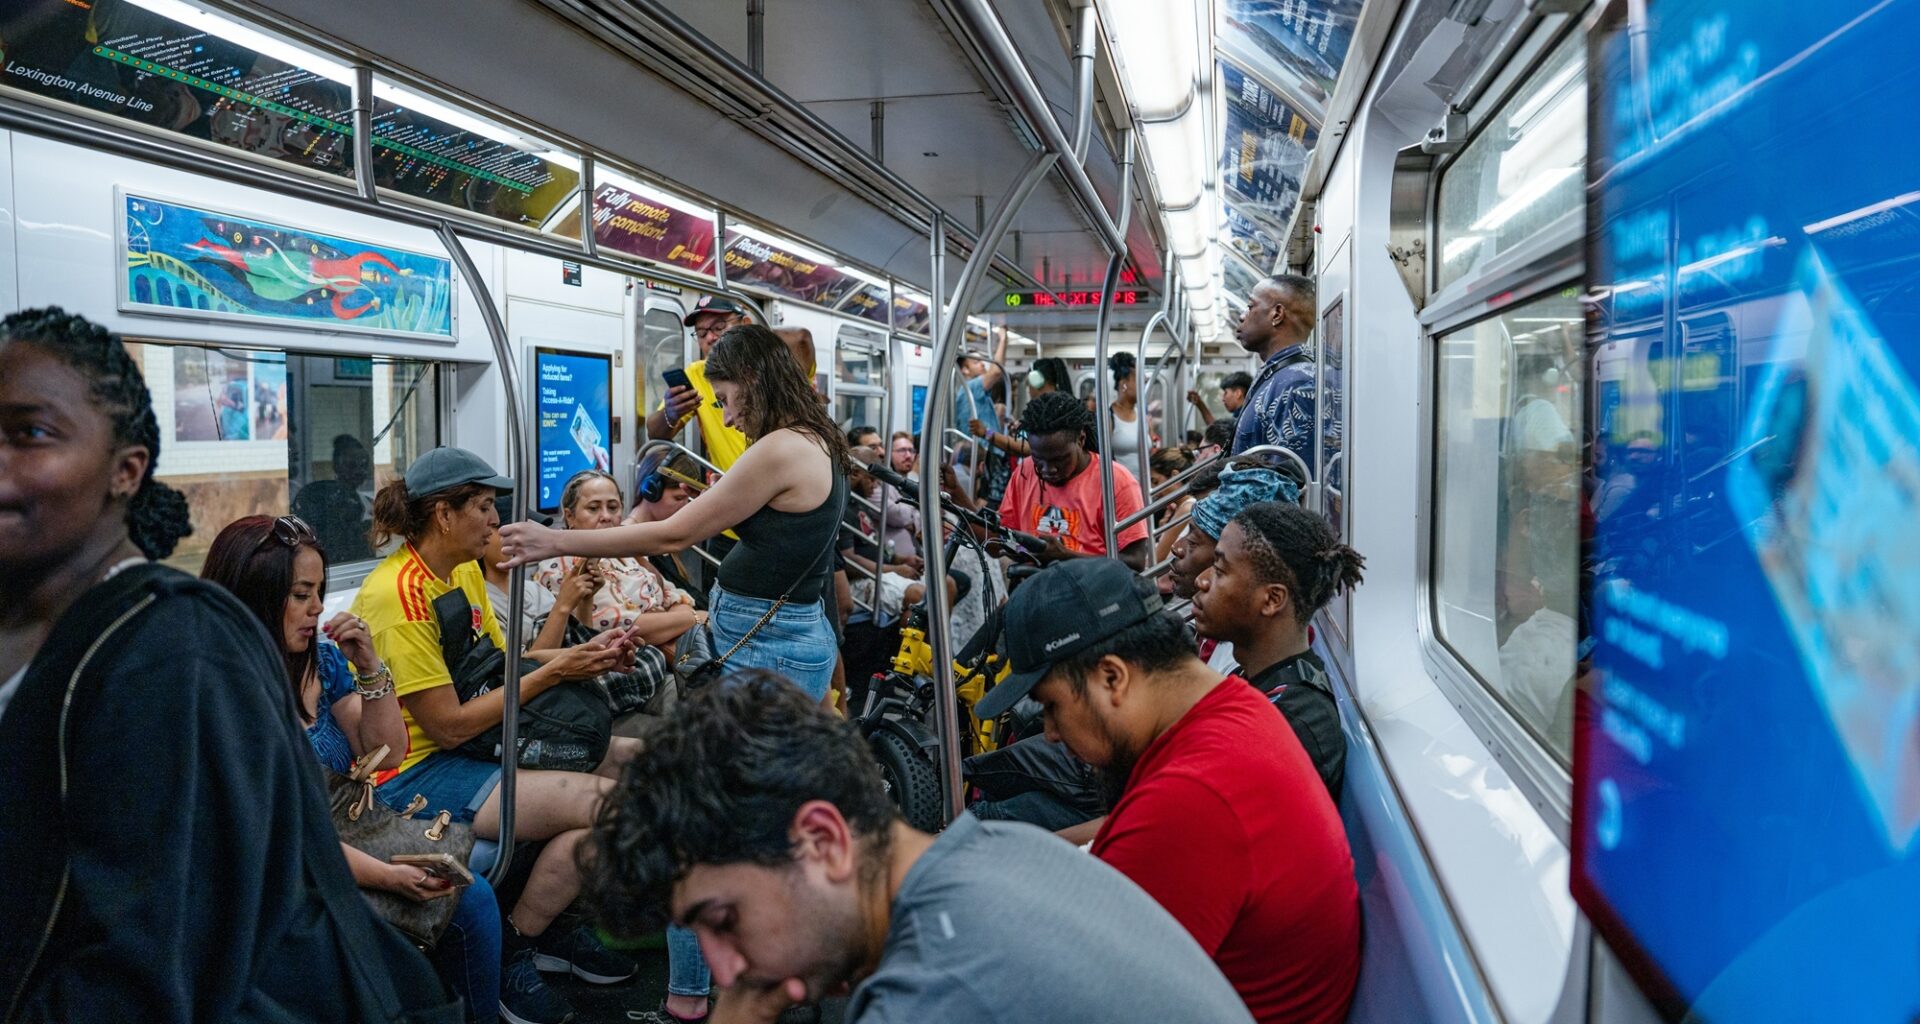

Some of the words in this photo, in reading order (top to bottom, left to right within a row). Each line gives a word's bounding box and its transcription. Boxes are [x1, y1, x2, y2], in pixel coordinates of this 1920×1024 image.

[104, 34, 138, 45] Woodlawn
[118, 40, 145, 50] Mosholu
[131, 45, 156, 54] Bedford
[156, 52, 182, 62] Fordham
[5, 60, 77, 90] Lexington
[77, 82, 126, 104] Avenue
[127, 96, 154, 112] Line
[597, 187, 632, 210] Fully
[626, 200, 671, 222] remote.
[609, 215, 668, 240] compliant.
[724, 249, 736, 262] to
[731, 255, 753, 269] zero
[1006, 294, 1021, 306] (4)
[1090, 291, 1121, 304] SP
[1124, 291, 1136, 304] IS
[542, 363, 561, 373] Applying
[542, 386, 556, 397] Taking
[1052, 632, 1080, 649] Columbia
